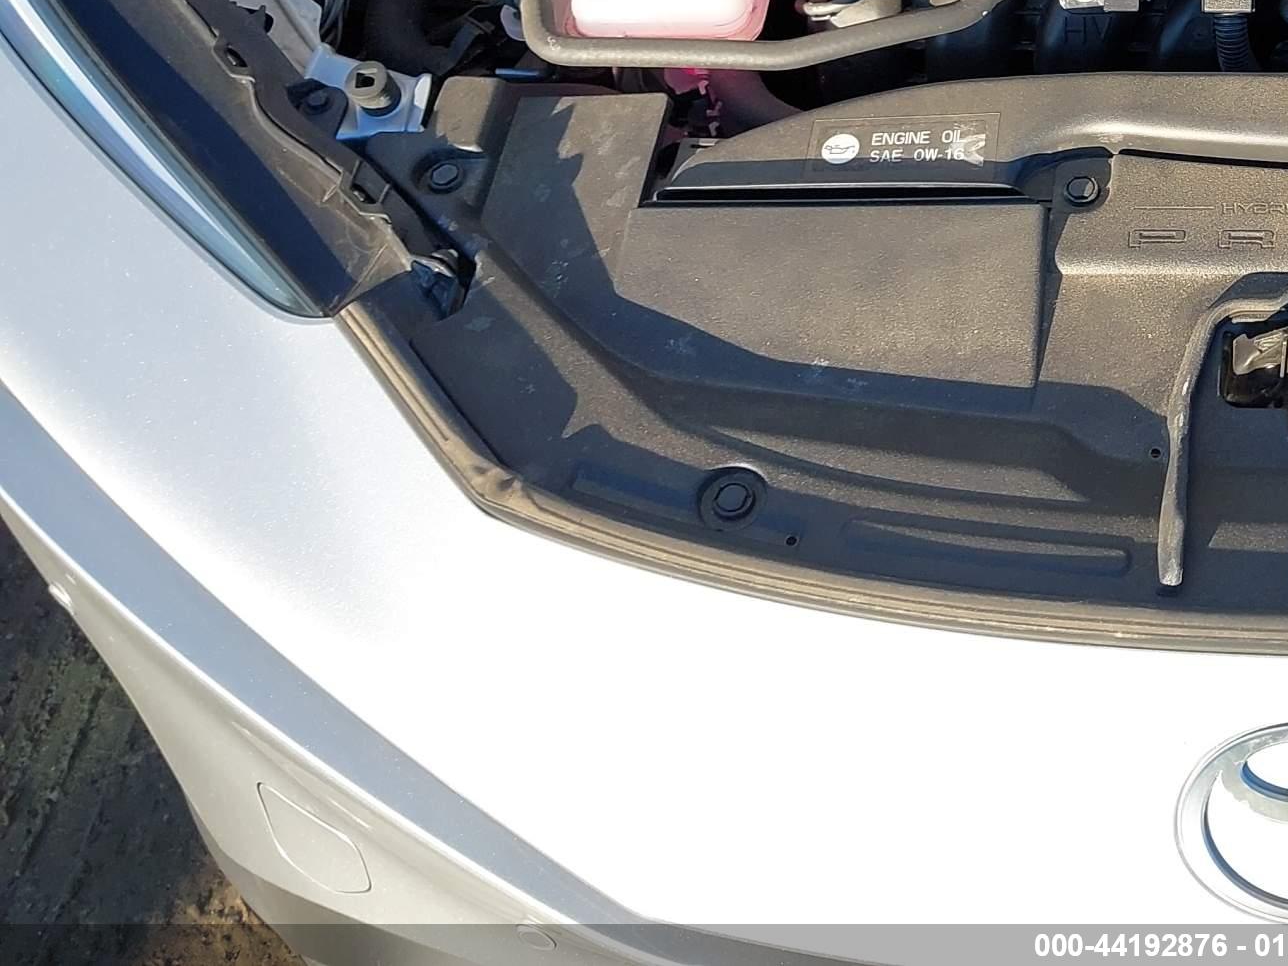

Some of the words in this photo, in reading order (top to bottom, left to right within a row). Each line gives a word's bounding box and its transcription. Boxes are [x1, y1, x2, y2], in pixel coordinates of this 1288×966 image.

[871, 130, 931, 146] ENGINE
[941, 129, 964, 144] OIL
[868, 148, 904, 163] SAE
[913, 148, 965, 162] 0W-16
